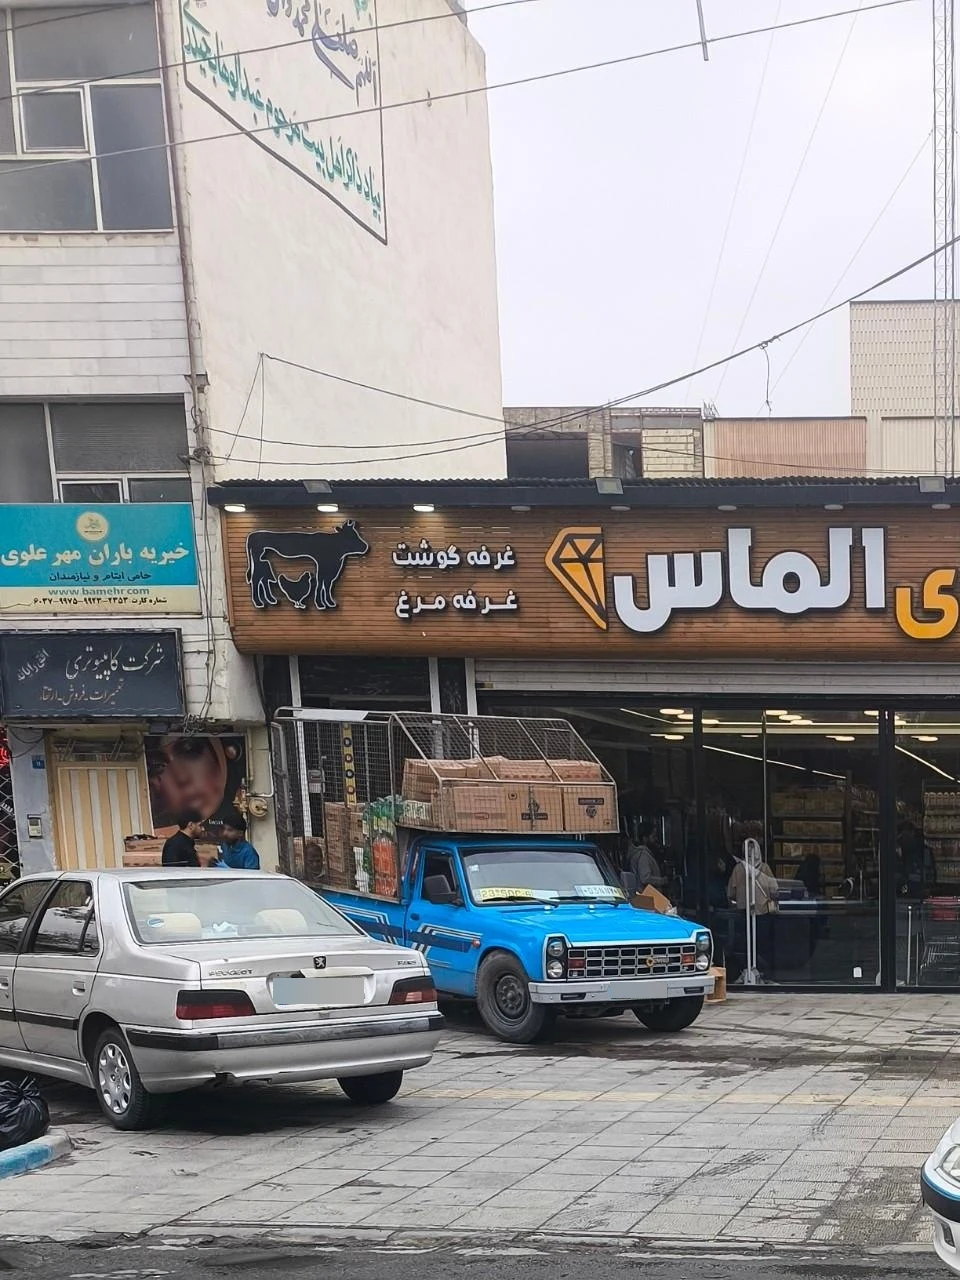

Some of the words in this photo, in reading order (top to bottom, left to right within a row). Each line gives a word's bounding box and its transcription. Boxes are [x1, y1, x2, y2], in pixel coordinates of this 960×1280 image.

[1, 543, 48, 567] علوی
[51, 549, 82, 566] مهر
[88, 543, 133, 566] باران
[139, 542, 190, 565] خیریه
[392, 538, 461, 569] گوشت
[465, 544, 516, 570] غرفه
[49, 571, 91, 582] نیازمندان
[93, 574, 99, 582] و
[102, 571, 125, 582] ایتام
[127, 571, 152, 582] حامی
[613, 527, 885, 633] الماس
[131, 596, 148, 605] کارت
[149, 596, 168, 606] شماره
[395, 589, 447, 618] مرغ
[452, 589, 518, 615] غرفه
[65, 644, 122, 681] کامپیوتری
[122, 642, 165, 675] شرکت
[62, 683, 86, 706] فروش
